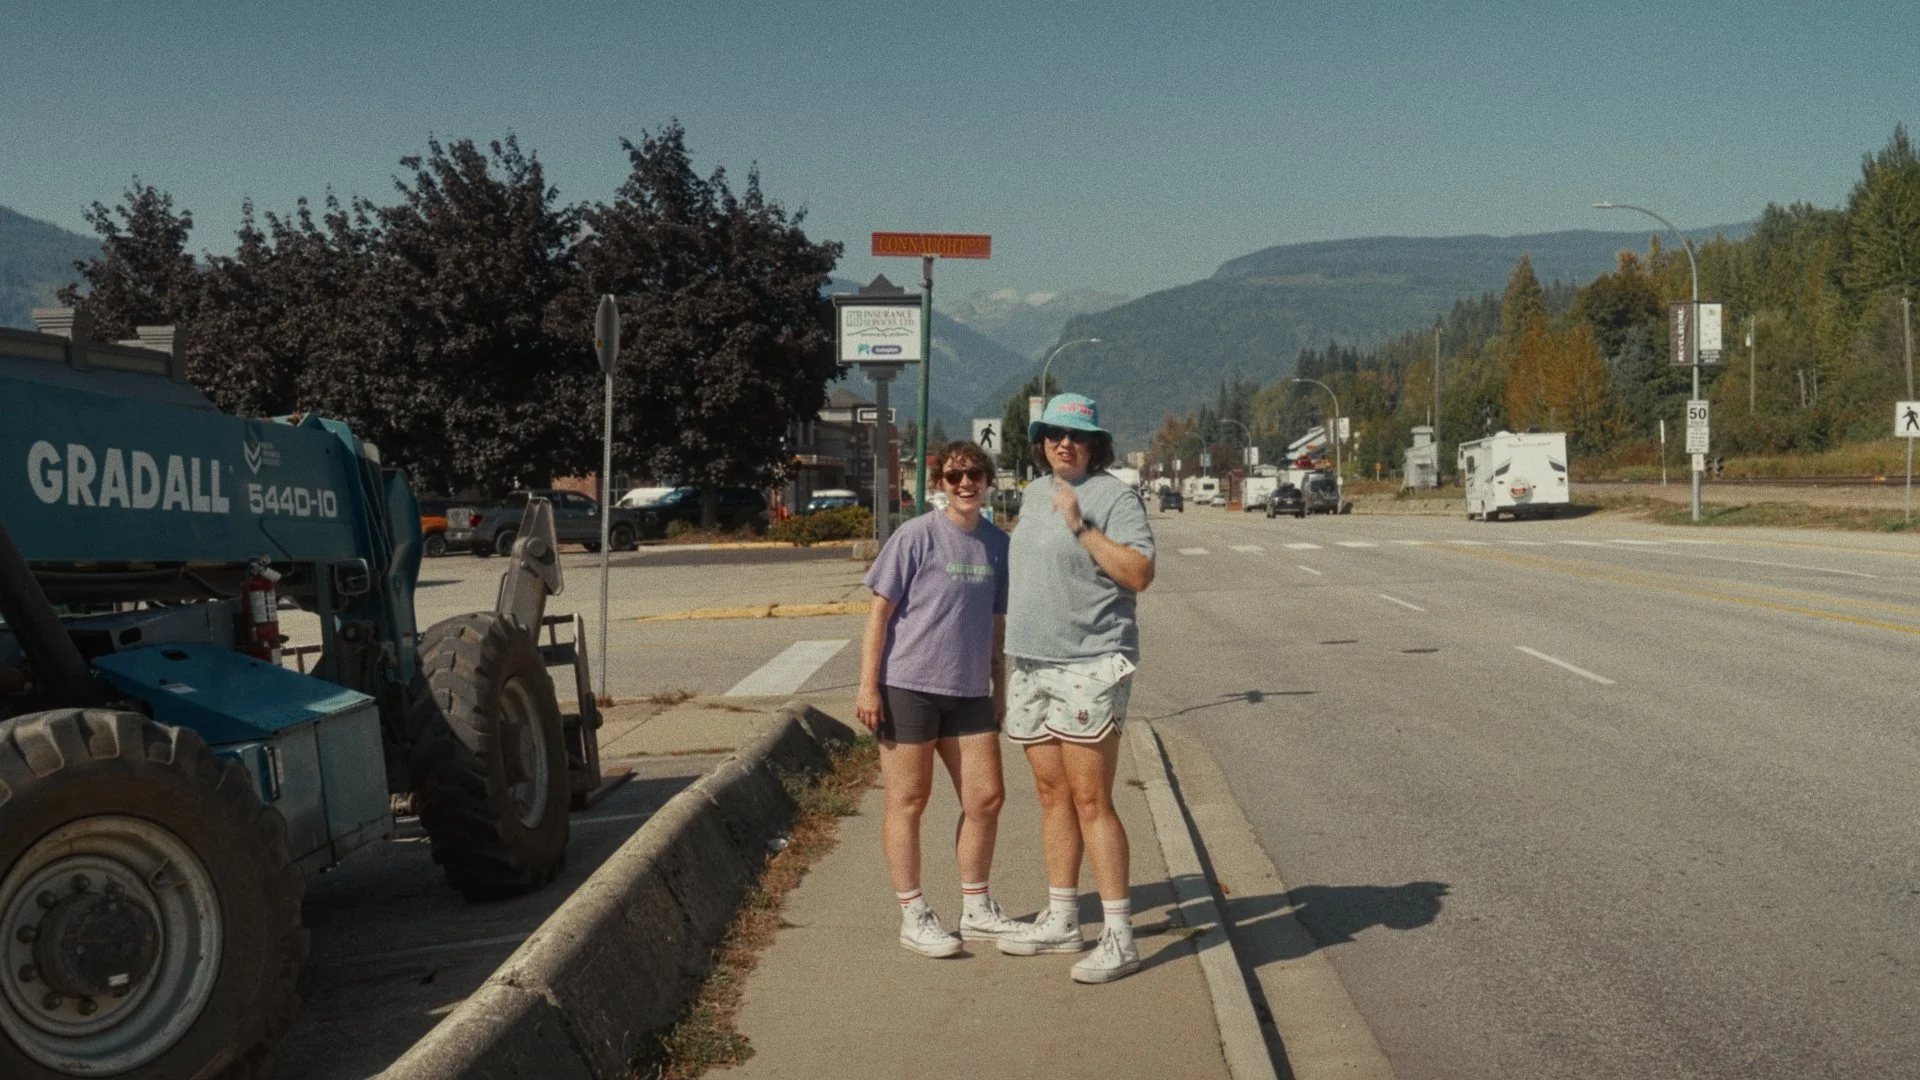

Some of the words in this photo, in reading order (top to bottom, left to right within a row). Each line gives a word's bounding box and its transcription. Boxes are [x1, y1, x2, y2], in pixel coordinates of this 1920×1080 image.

[878, 236, 966, 254] CONNAUGHT
[863, 310, 912, 318] INSURANCE
[1677, 306, 1685, 362] REVELSTOKE
[1689, 407, 1707, 420] 50
[27, 440, 230, 514] GRADALL
[248, 482, 337, 518] 544D-10
